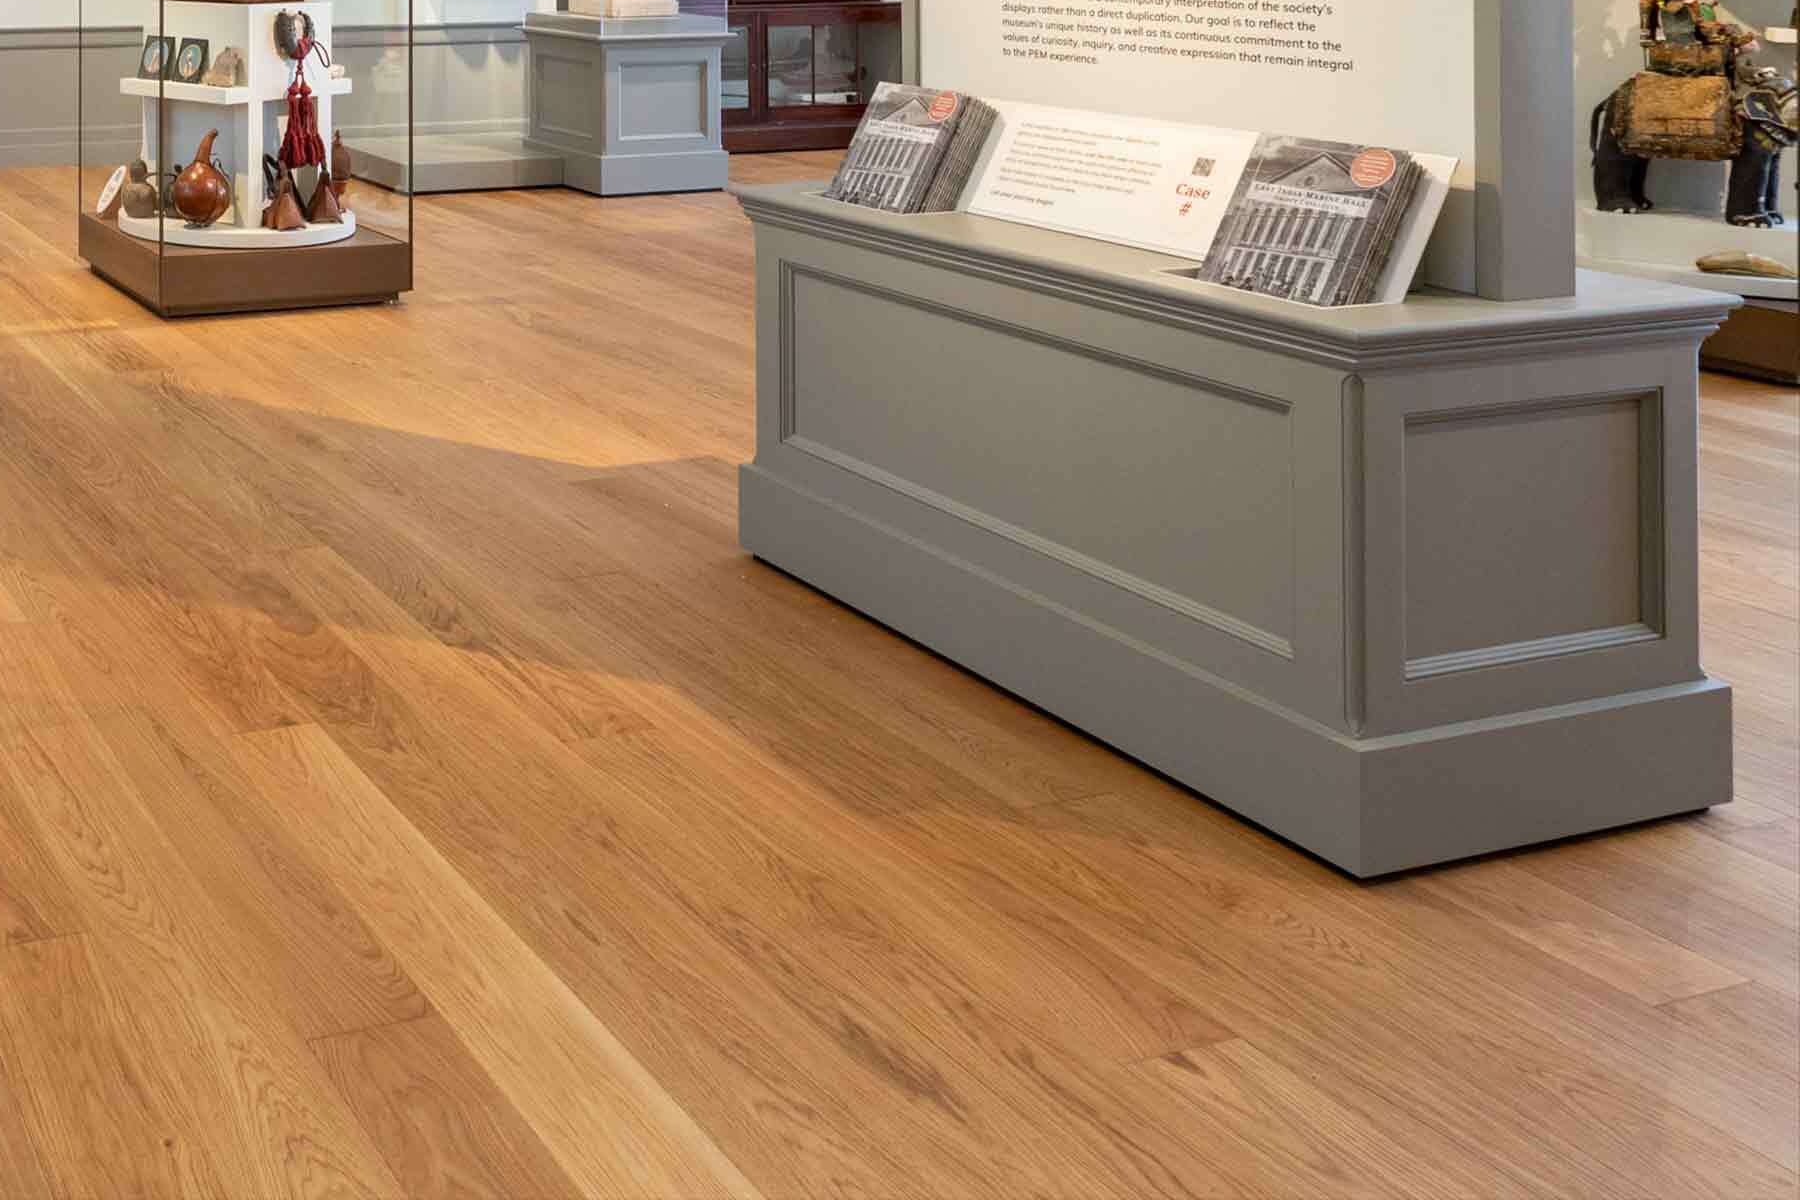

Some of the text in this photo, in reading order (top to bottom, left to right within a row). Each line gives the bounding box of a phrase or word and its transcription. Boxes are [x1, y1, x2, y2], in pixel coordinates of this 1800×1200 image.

[1247, 0, 1259, 10] of
[1261, 0, 1280, 11] the
[1184, 13, 1204, 23] Our
[1206, 16, 1230, 26] goal
[1232, 16, 1242, 26] is
[1244, 17, 1256, 27] to
[1258, 18, 1294, 30] reflect
[1296, 20, 1316, 31] the
[1145, 29, 1157, 37] as
[1159, 28, 1172, 38] its
[1174, 30, 1231, 43] continuous
[1233, 35, 1304, 48] commitment
[1306, 39, 1319, 50] to
[1322, 40, 1342, 51] the
[1138, 44, 1354, 72] creative expression that remain integral
[1175, 183, 1210, 200] Case
